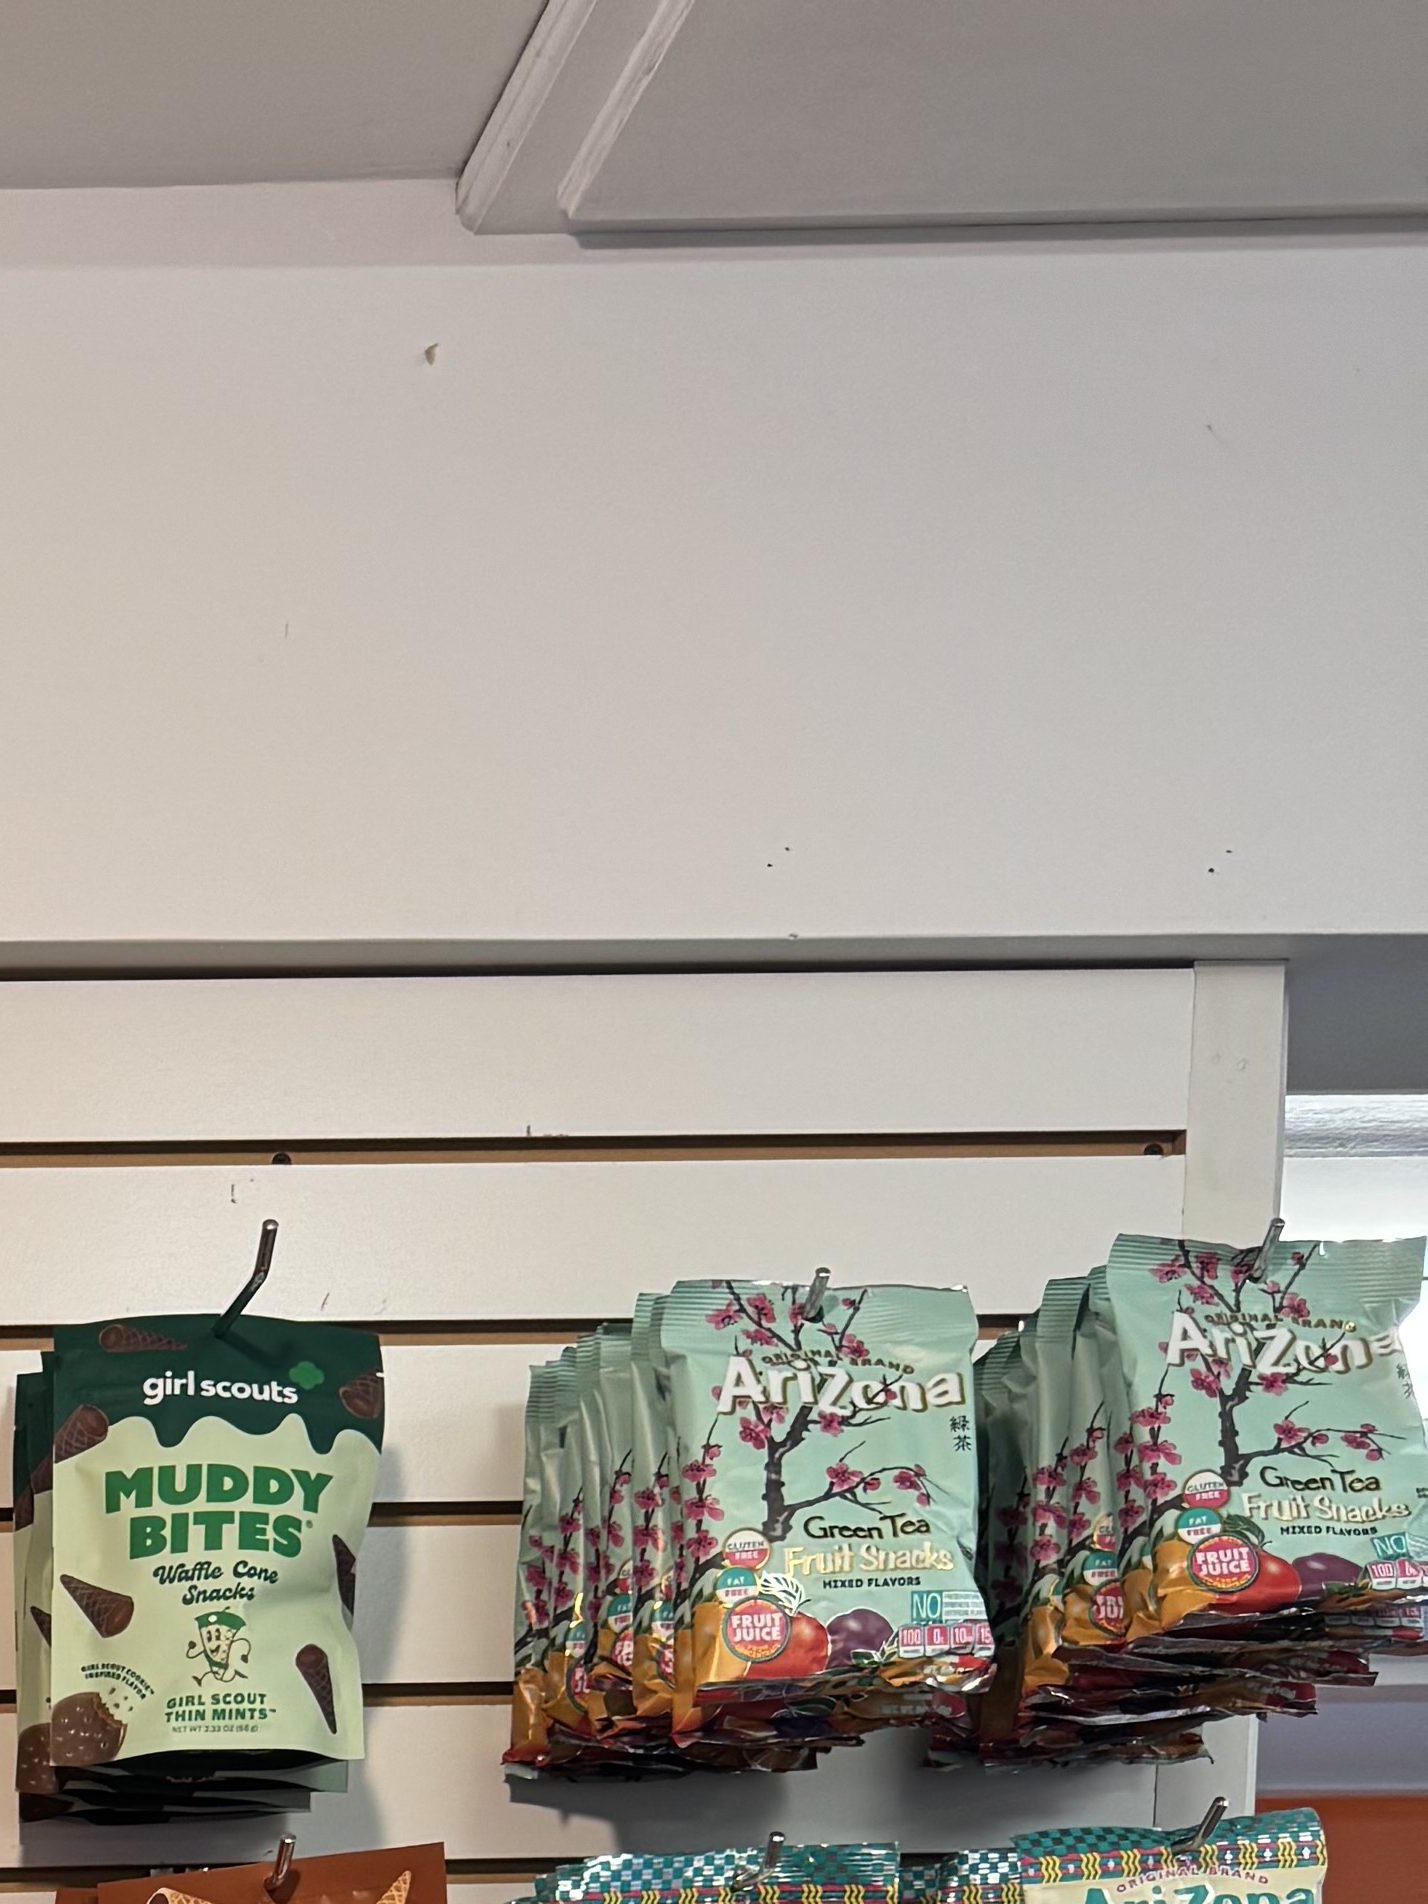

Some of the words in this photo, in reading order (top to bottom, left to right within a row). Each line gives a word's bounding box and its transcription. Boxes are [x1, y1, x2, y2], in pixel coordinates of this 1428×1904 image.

[143, 1370, 194, 1405] girl
[199, 1377, 299, 1405] scouts
[717, 1355, 967, 1417] AriZona
[103, 1463, 334, 1514] MUDDY
[129, 1510, 302, 1560] BITES
[803, 1515, 885, 1540] Green
[890, 1511, 931, 1536] Tea
[783, 1545, 854, 1576] Fruit
[859, 1542, 953, 1574] Snacks
[1195, 1545, 1251, 1565] FRUIT
[1199, 1558, 1251, 1577] JUICE
[153, 1560, 223, 1587] Waffle
[232, 1560, 279, 1583] Cone
[822, 1577, 862, 1590] MIXED
[866, 1575, 922, 1589] FLAVORS
[181, 1583, 254, 1606] Snacks
[912, 1592, 942, 1617] NO
[731, 1612, 781, 1630] FRUIT
[733, 1626, 782, 1643] JUICE
[165, 1693, 206, 1710] GIRL
[209, 1691, 267, 1706] SCOUT
